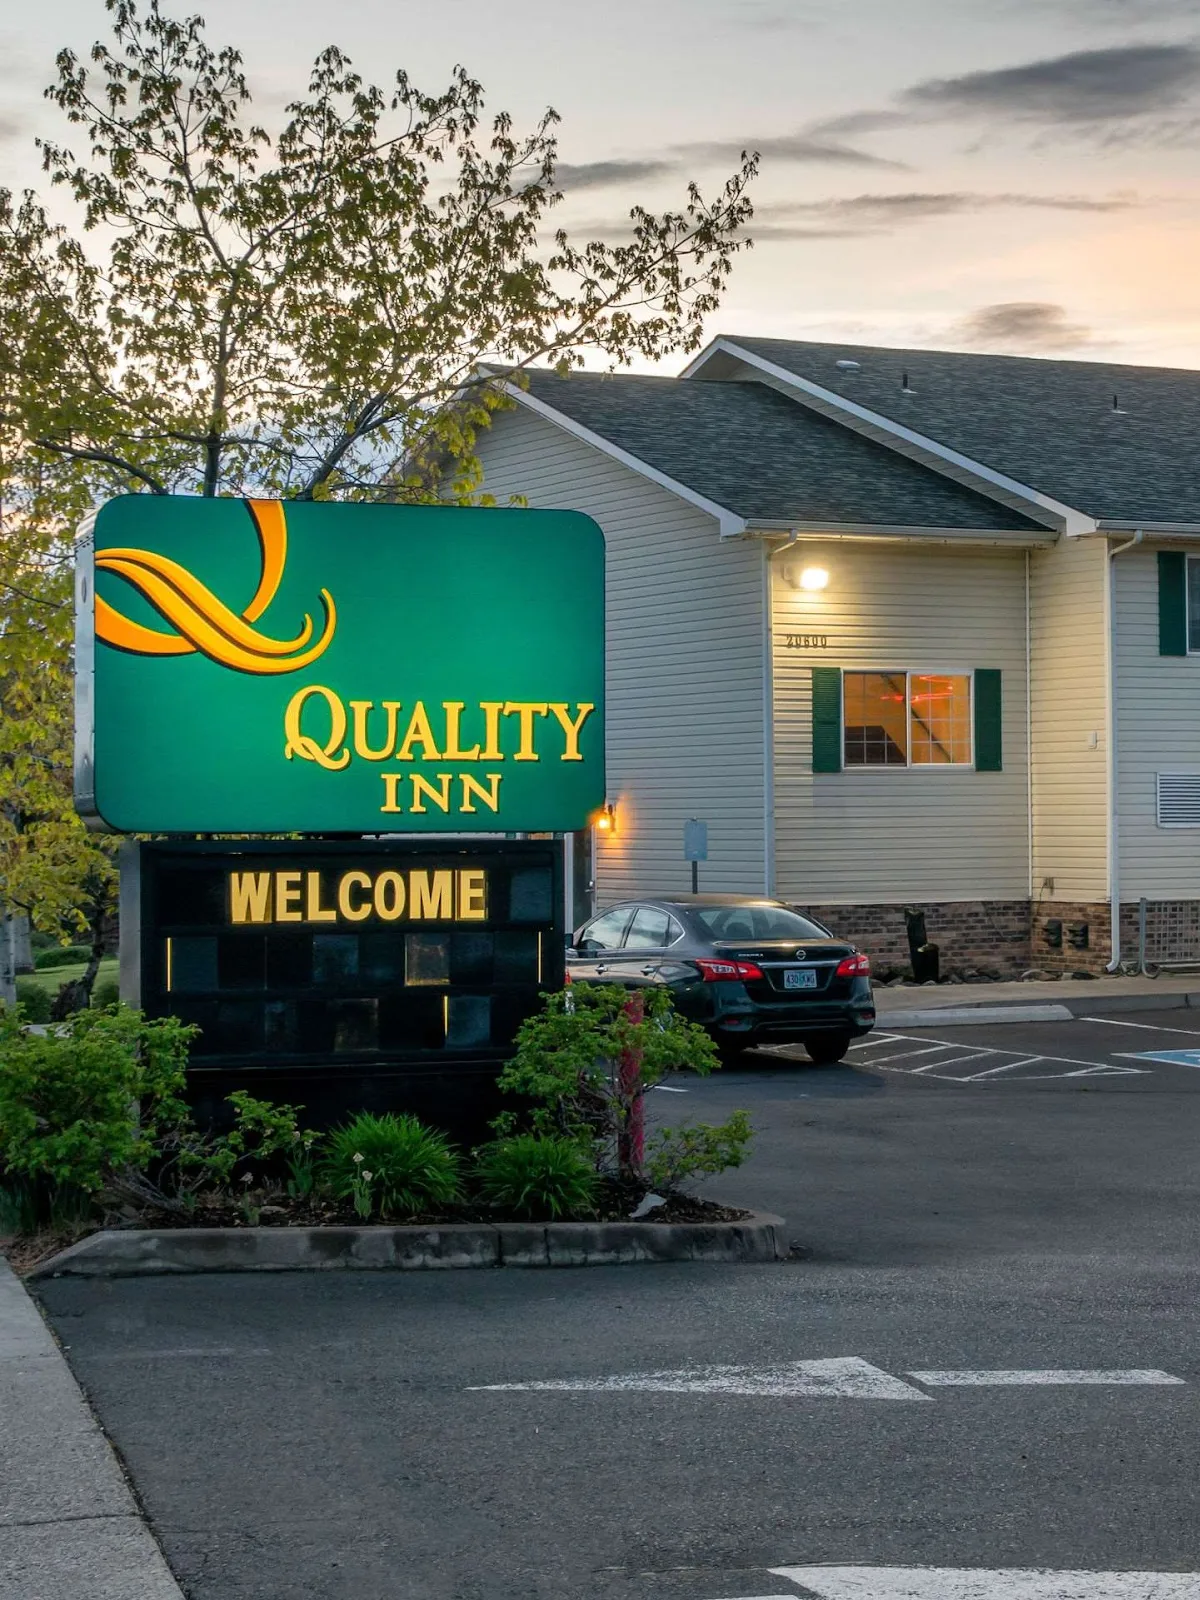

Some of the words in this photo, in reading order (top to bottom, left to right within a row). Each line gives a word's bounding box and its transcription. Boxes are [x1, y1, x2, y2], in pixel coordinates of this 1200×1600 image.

[786, 634, 827, 648] 20600
[284, 685, 594, 770] QUALITY
[381, 773, 502, 813] INN
[231, 870, 486, 923] WELCOME
